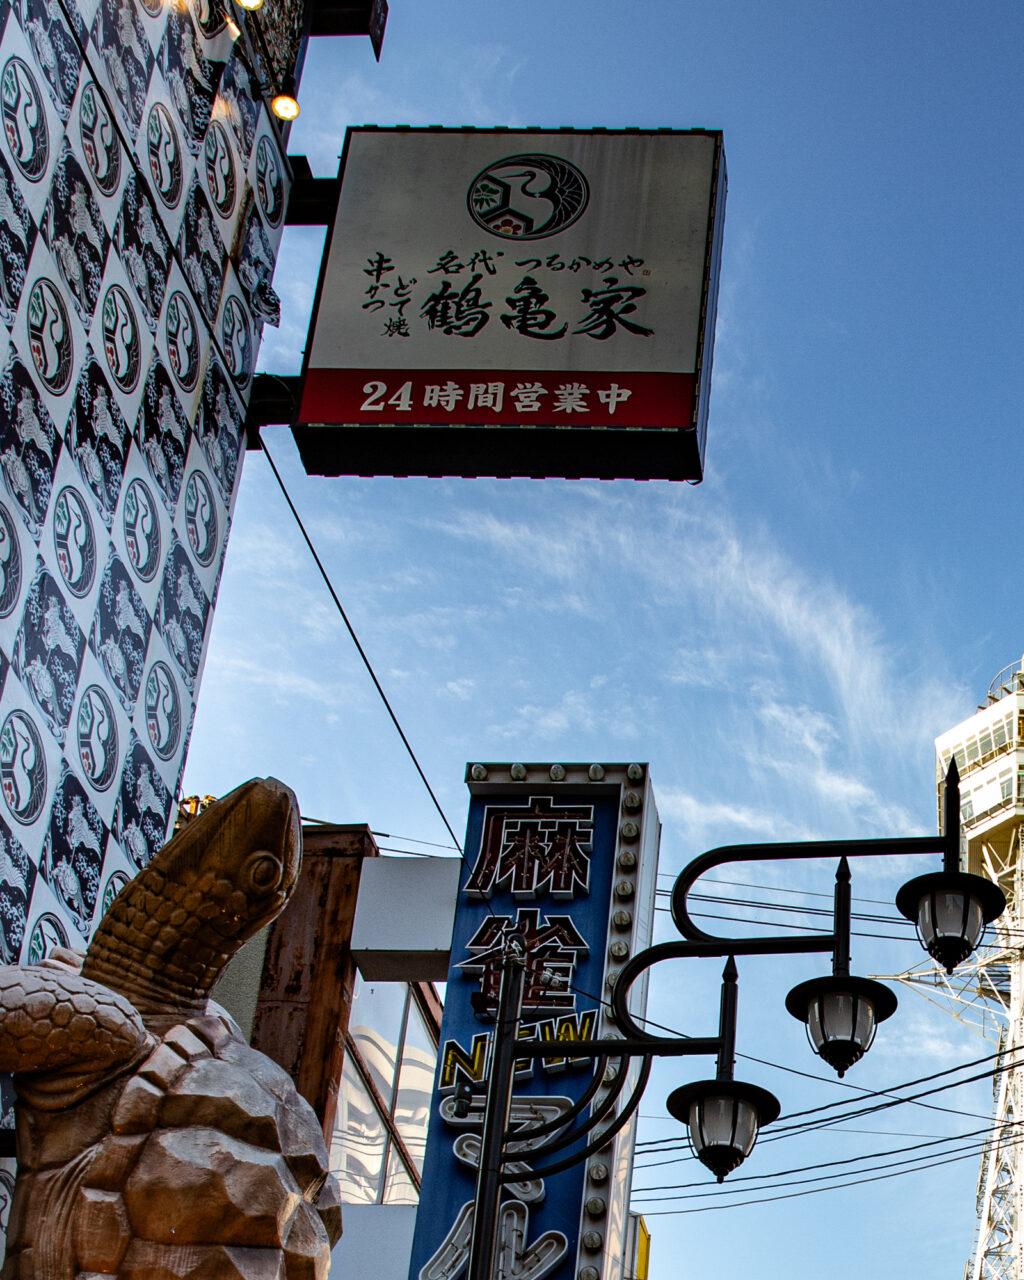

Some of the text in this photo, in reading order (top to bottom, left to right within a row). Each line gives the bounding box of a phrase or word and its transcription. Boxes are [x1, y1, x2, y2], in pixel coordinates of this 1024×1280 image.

[361, 251, 395, 313] 串かつ
[427, 249, 505, 276] 名代
[514, 252, 645, 276] つるかめや
[380, 276, 418, 338] どて焼
[420, 273, 656, 341] 鶴亀家
[359, 380, 634, 415] 24時間営業中
[462, 796, 596, 1018] 麻雀
